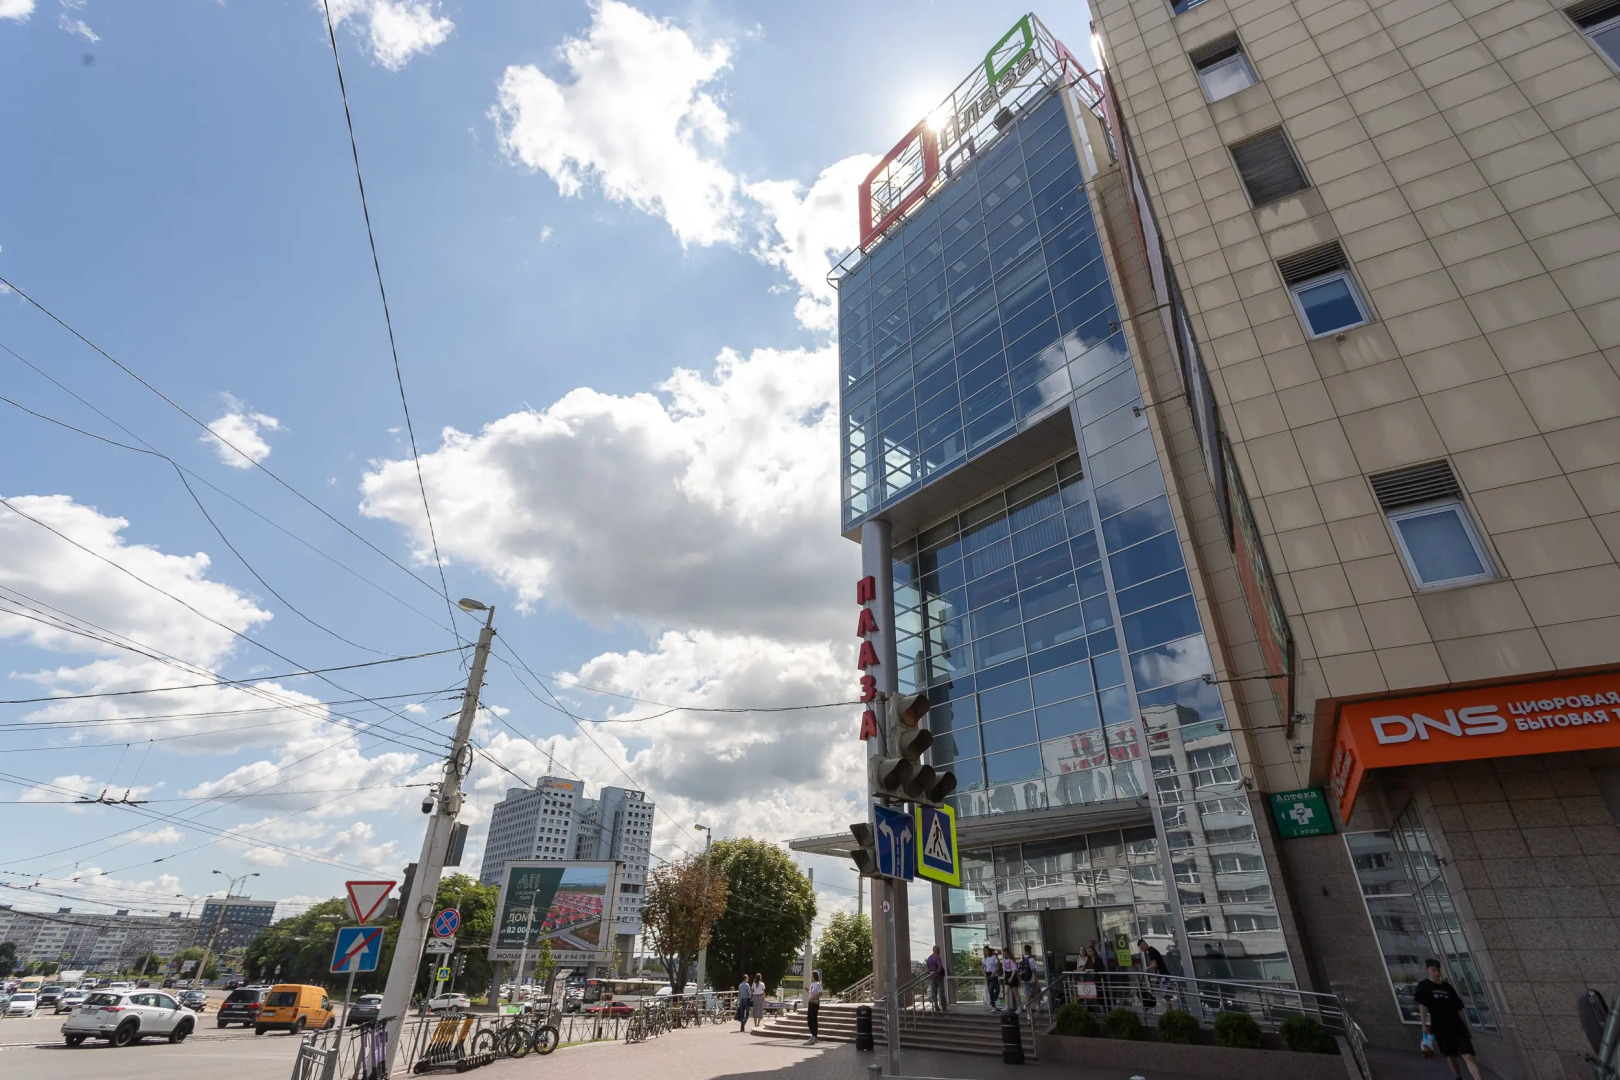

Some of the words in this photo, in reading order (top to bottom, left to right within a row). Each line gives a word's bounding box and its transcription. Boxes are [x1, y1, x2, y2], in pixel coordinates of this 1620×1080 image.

[857, 575, 880, 741] ПЛАЗА
[1507, 691, 1620, 715] ЦИФРОВАЯ
[1370, 704, 1508, 744] DNS
[1514, 709, 1610, 731] БЫТОВАЯ
[1276, 791, 1317, 802] Аптека
[506, 926, 516, 934] 82
[516, 926, 528, 934] 00
